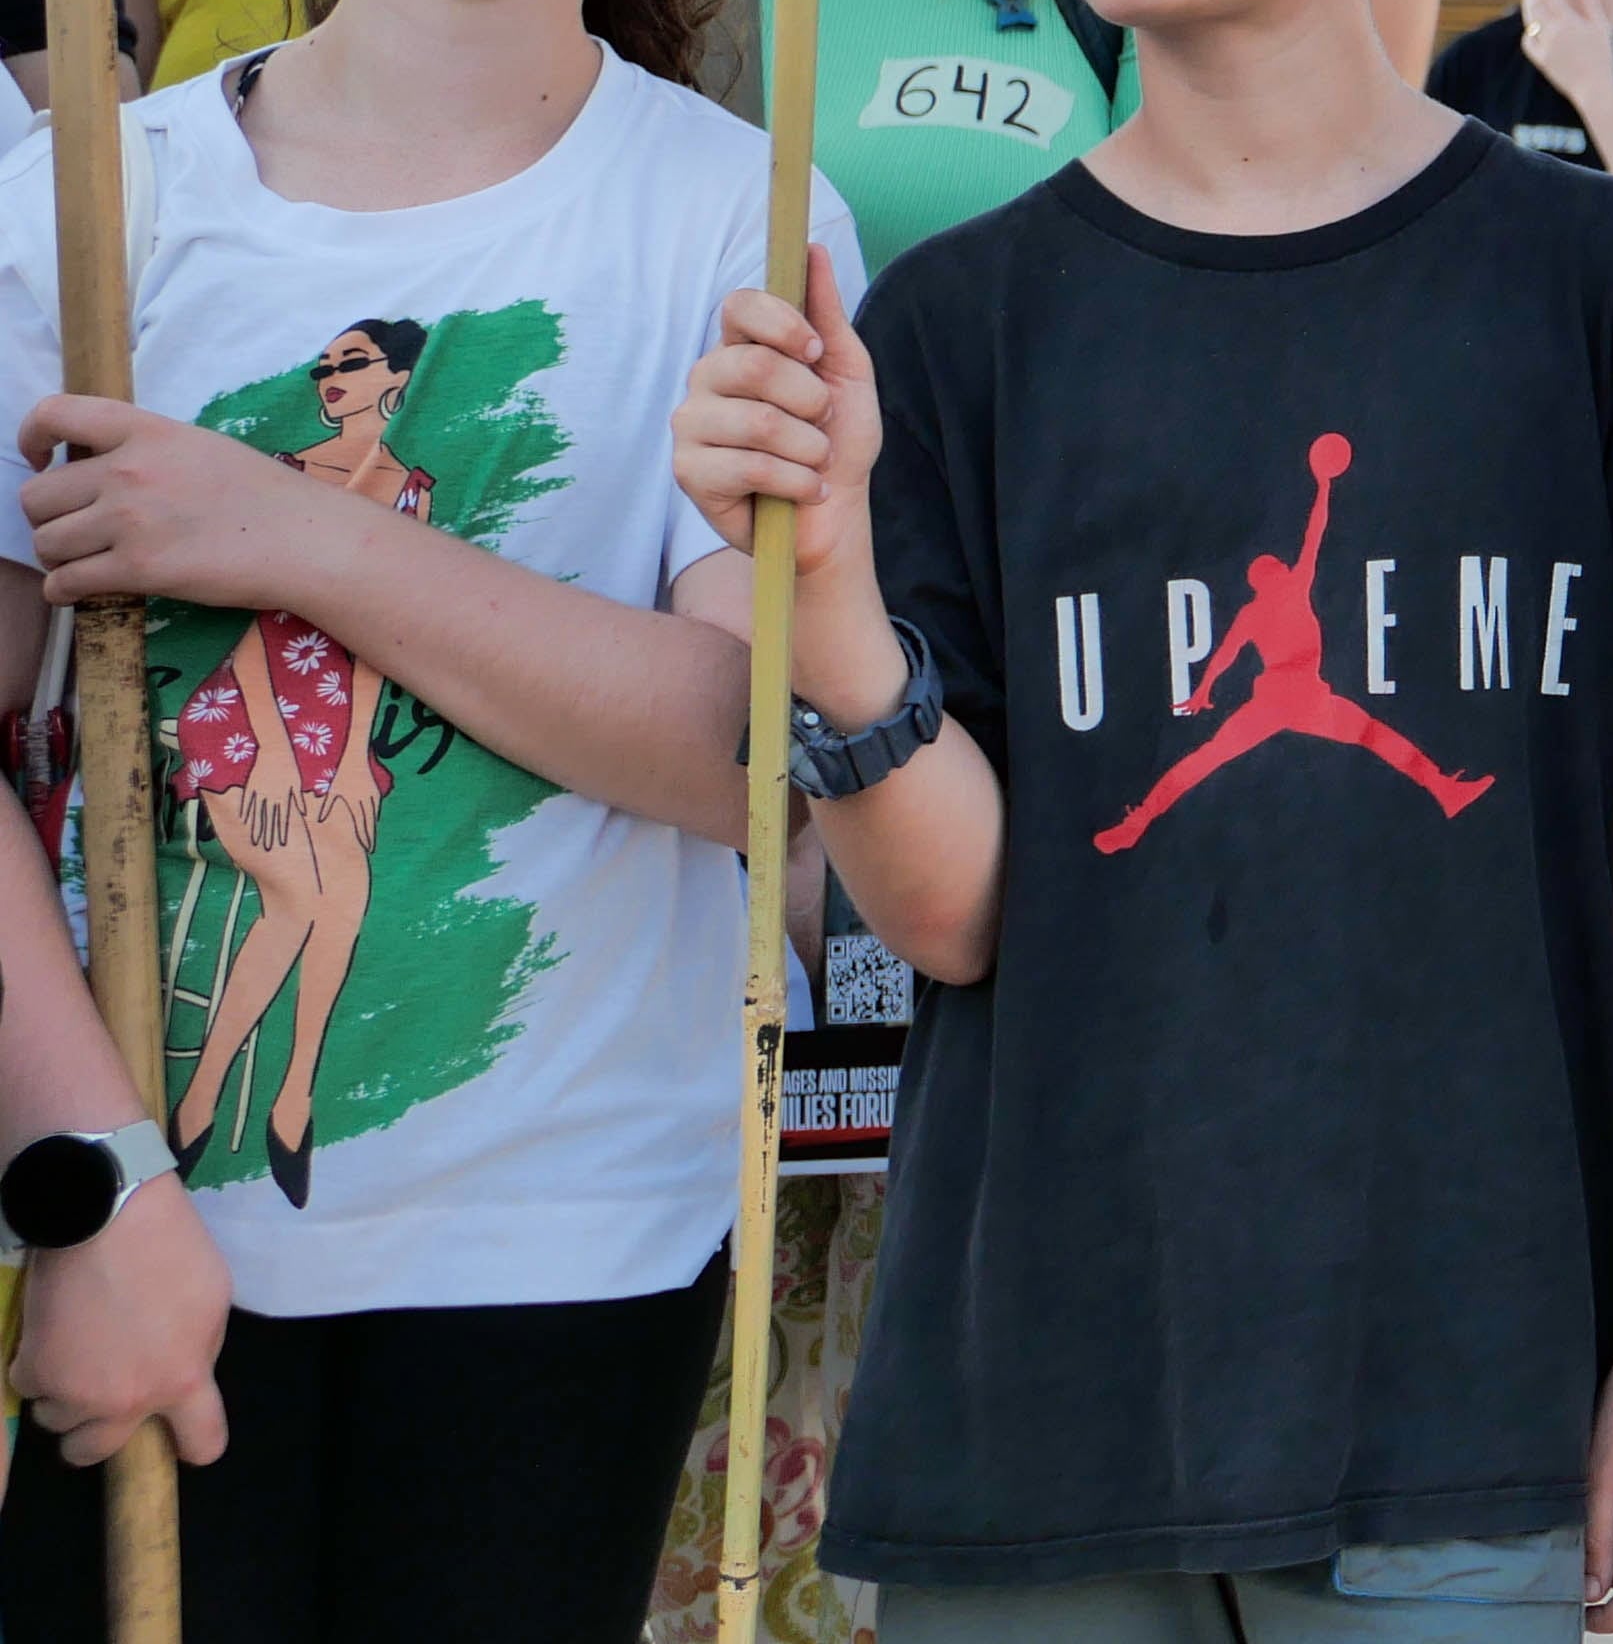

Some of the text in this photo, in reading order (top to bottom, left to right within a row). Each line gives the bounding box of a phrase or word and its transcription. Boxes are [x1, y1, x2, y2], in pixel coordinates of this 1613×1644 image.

[895, 63, 1042, 136] 642
[783, 1067, 901, 1093] AGES AND MISSIN
[841, 1092, 897, 1128] FORU
